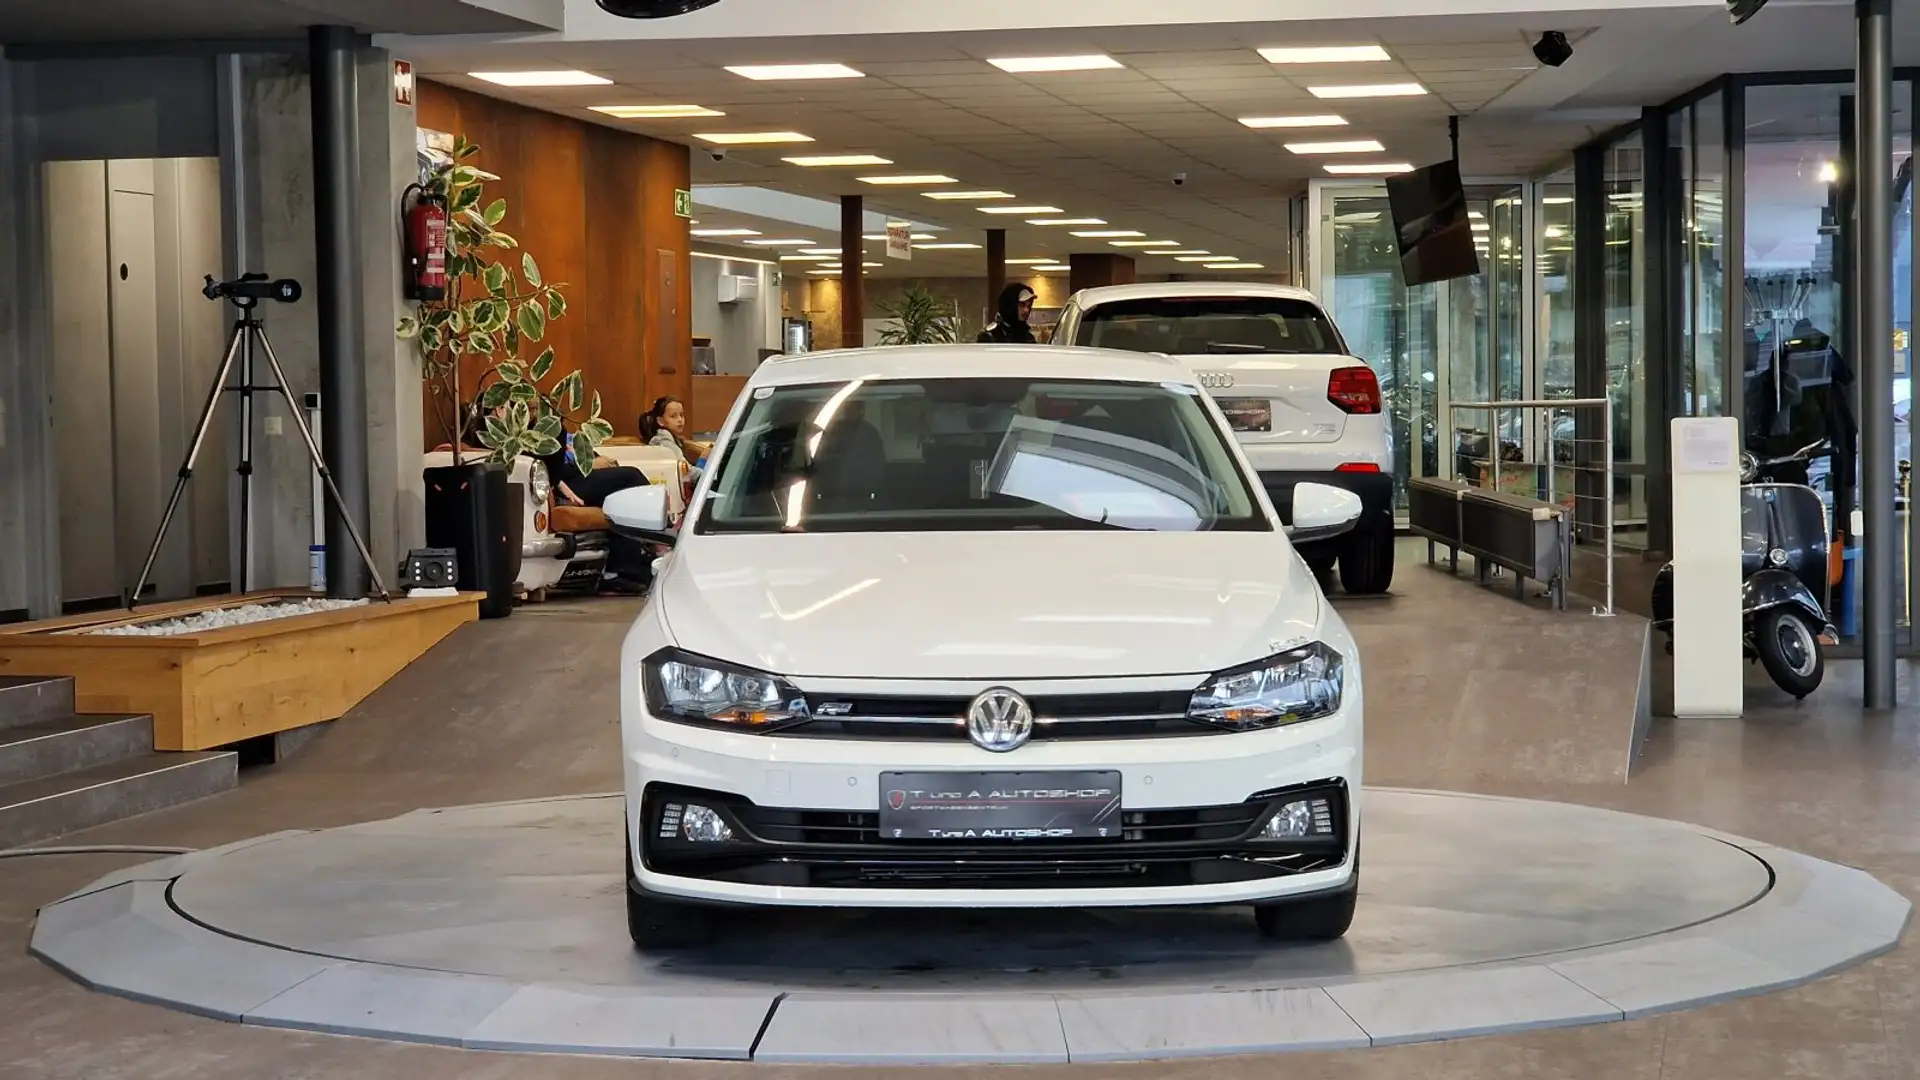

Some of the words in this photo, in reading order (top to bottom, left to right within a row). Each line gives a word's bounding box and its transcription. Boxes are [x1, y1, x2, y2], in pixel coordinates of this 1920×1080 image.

[909, 790, 925, 798] T
[966, 789, 981, 798] A
[988, 788, 1112, 798] AUTOSHOP
[981, 828, 1073, 838] AUTOSHOP
